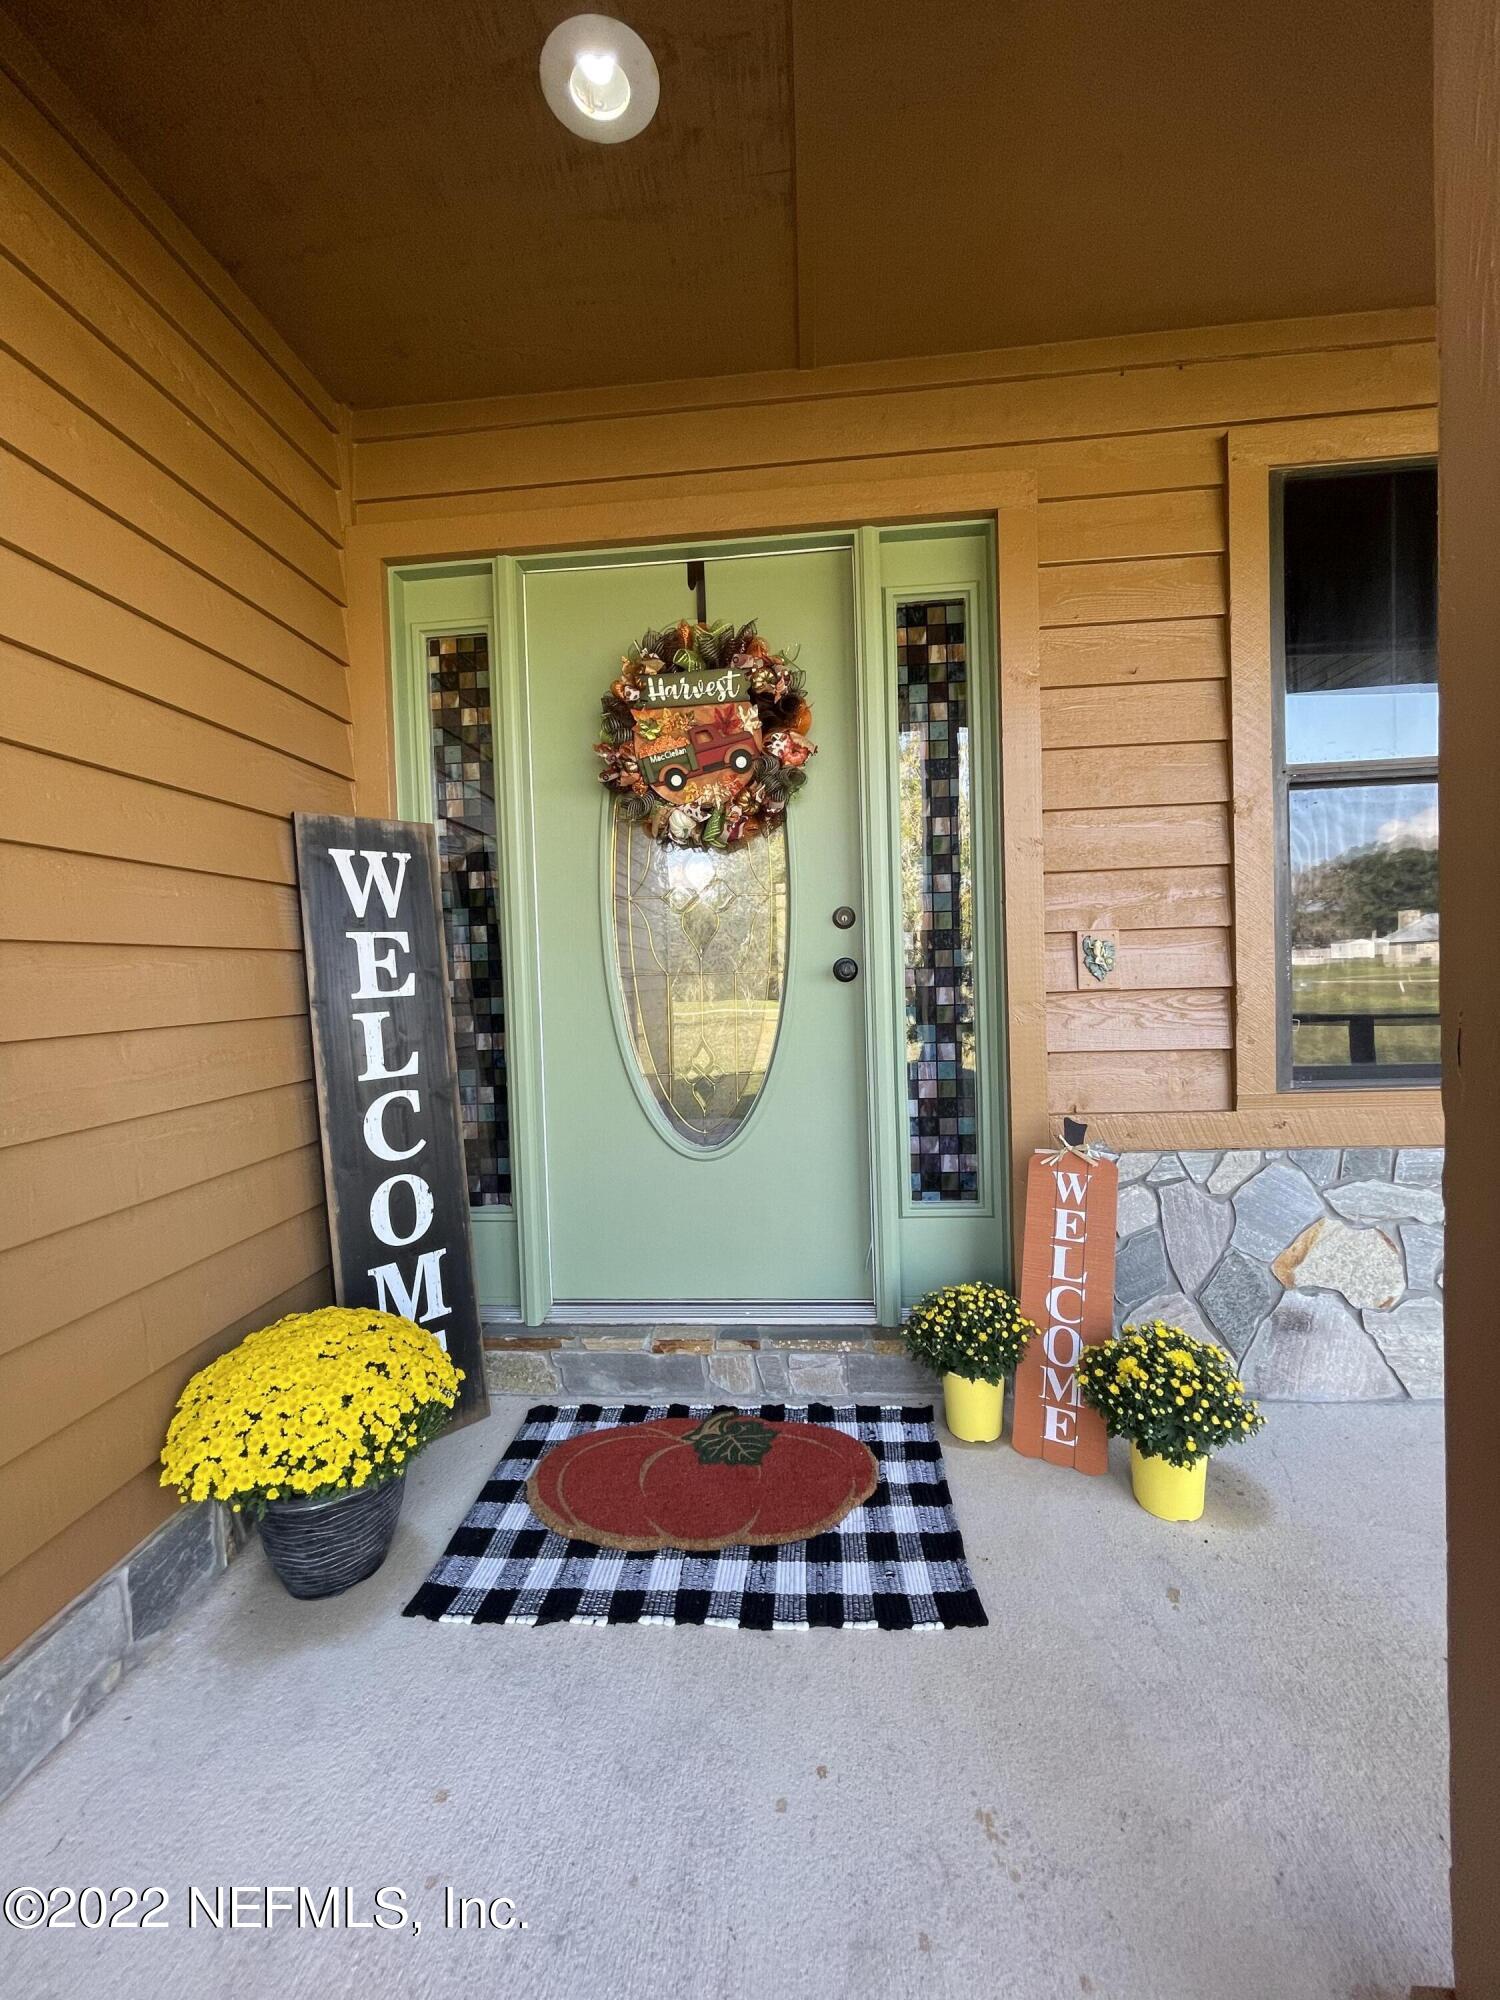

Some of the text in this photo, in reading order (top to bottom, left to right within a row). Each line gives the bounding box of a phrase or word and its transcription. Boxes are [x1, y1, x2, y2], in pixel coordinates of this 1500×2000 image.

[648, 670, 741, 702] Harvest
[328, 847, 452, 1352] WELCOM
[1038, 1171, 1092, 1447] WELCOME
